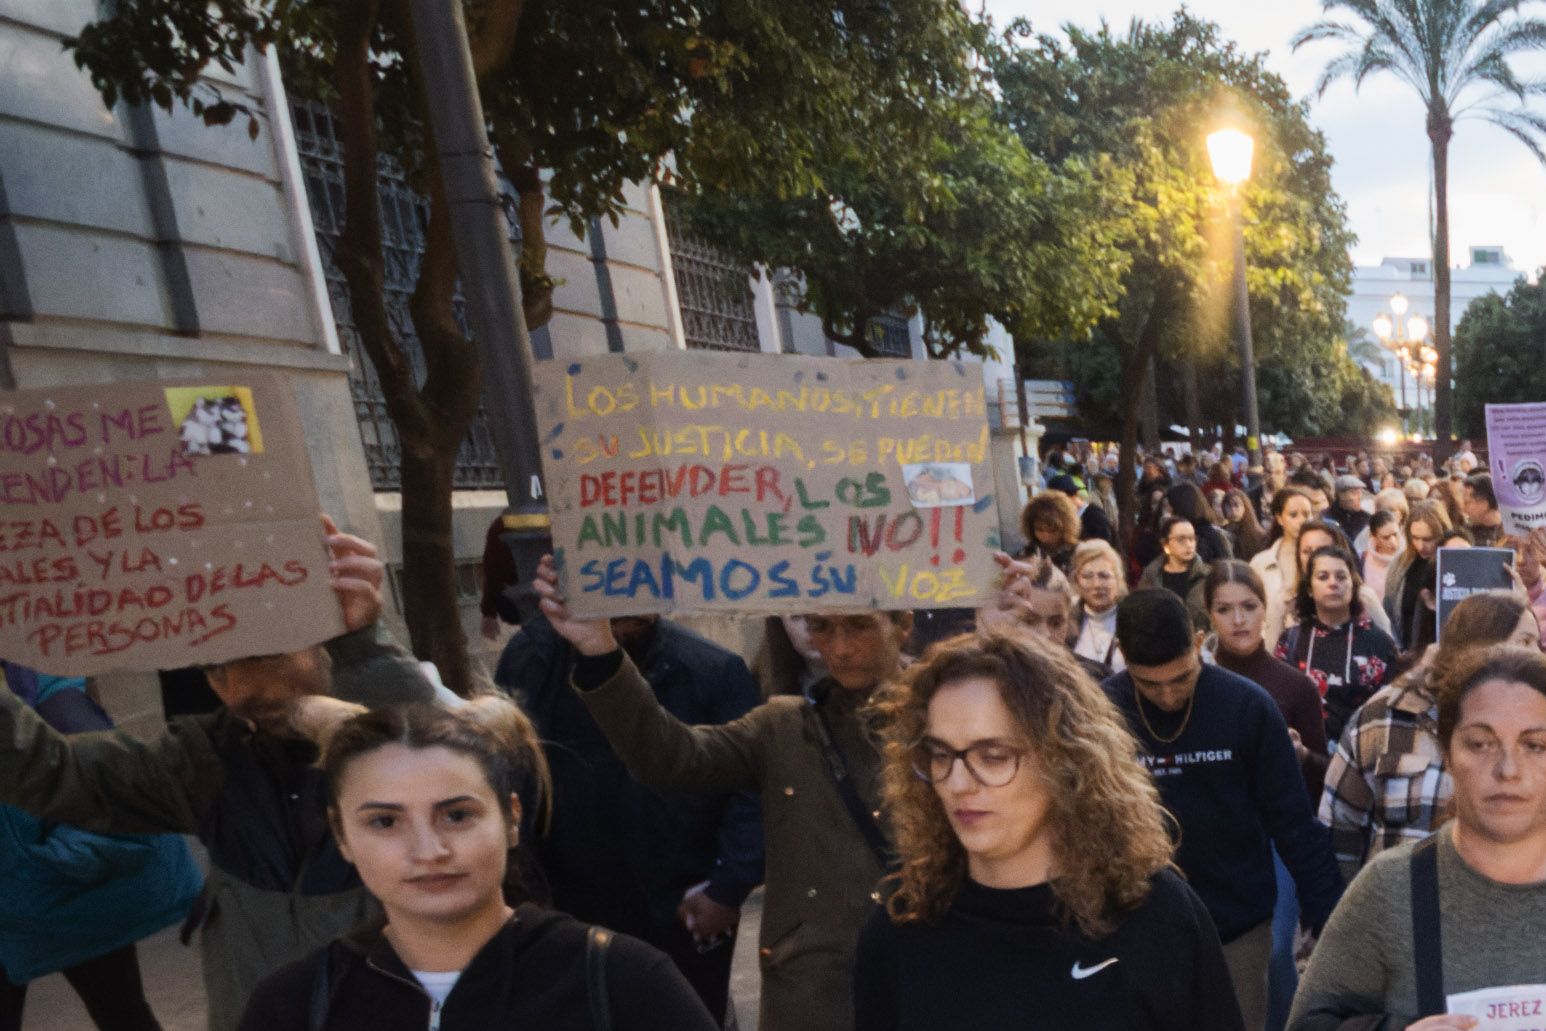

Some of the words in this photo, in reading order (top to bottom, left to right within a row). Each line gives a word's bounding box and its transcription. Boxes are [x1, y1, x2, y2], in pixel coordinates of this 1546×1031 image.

[565, 374, 640, 419] LOS
[101, 405, 165, 445] ME
[574, 432, 620, 464] SU
[795, 472, 892, 510] LOS
[73, 506, 122, 548] DE
[134, 503, 205, 534] LOS
[577, 504, 827, 551] ANIMALES
[121, 547, 163, 574] LA
[580, 552, 800, 600] SEAMOS
[879, 564, 979, 602] VOZ
[27, 603, 238, 655] PERSONAS
[1175, 749, 1232, 765] HILFIGER
[1487, 998, 1543, 1021] JEREZ
